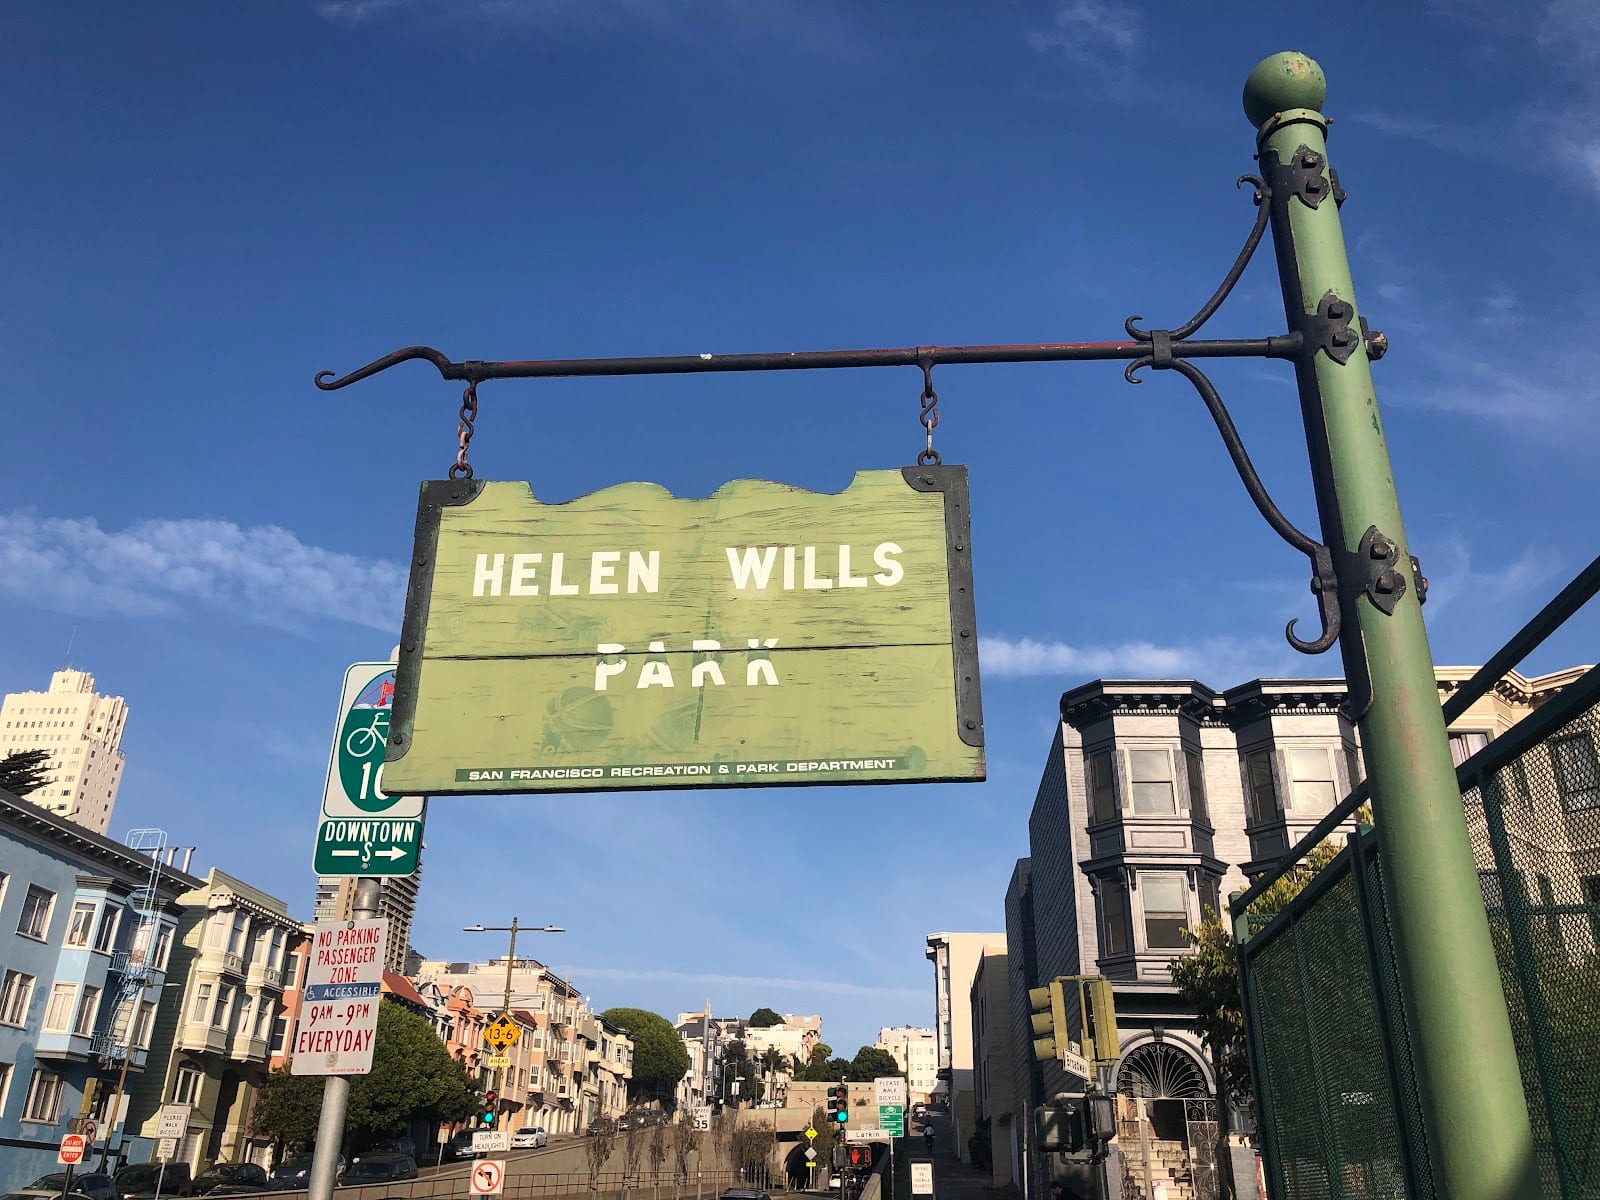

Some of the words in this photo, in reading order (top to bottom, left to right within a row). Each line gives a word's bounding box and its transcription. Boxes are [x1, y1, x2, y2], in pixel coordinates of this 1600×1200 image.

[472, 551, 661, 597] HELEN
[725, 542, 904, 590] WILLS
[594, 638, 780, 691] PARK
[469, 770, 503, 780] SAN
[510, 768, 603, 780] FRANCISCO
[611, 764, 711, 777] RECREATION
[718, 764, 730, 774] &
[737, 763, 779, 773] PARK
[786, 760, 896, 772] DEPARTMENT
[325, 821, 415, 843] DOWNTOWN
[361, 841, 373, 862] S
[319, 930, 332, 948] NO
[337, 927, 380, 946] PARKING
[317, 946, 376, 966] PASSENGER
[330, 966, 358, 984] ZONE
[323, 986, 380, 998] ACCESSIBLE
[309, 1004, 333, 1027] 9AM
[345, 1003, 370, 1026] 9PM
[299, 1029, 374, 1054] EVERYDAY
[489, 1028, 513, 1040] 13-6
[694, 1119, 708, 1129] 35
